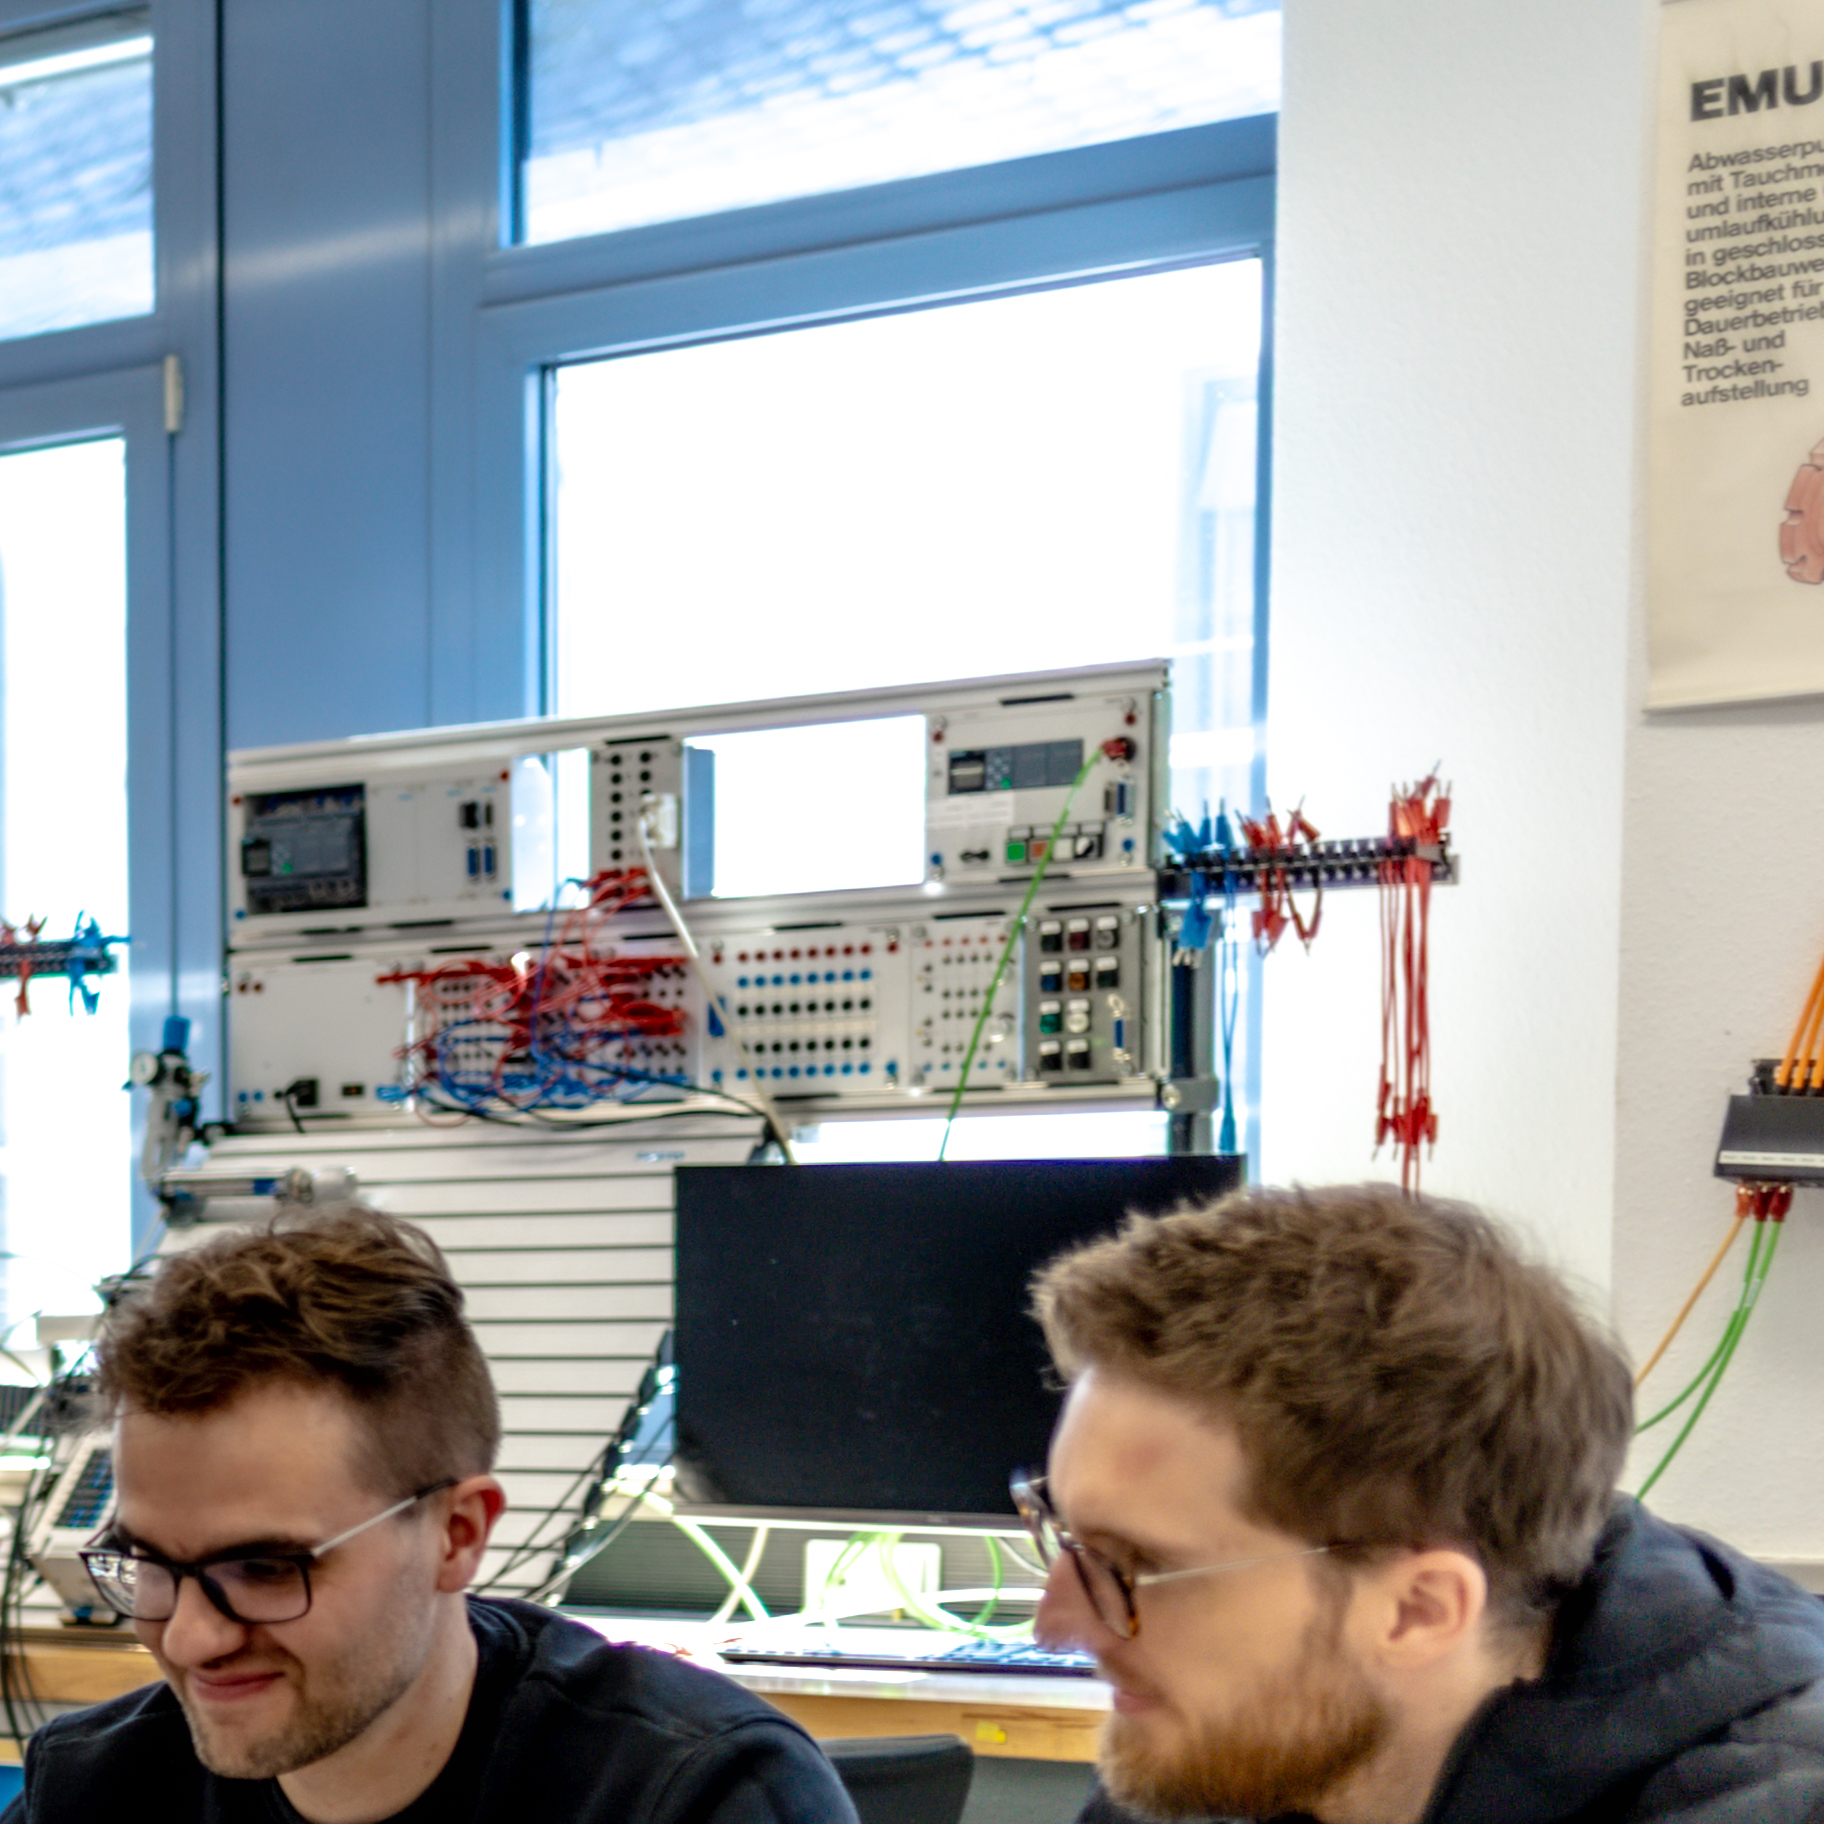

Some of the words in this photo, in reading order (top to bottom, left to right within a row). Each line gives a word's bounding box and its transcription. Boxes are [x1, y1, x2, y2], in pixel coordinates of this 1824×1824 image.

[1691, 60, 1824, 121] EMU
[1687, 174, 1724, 196] mit
[1686, 196, 1729, 219] und
[1736, 187, 1817, 213] interne
[1686, 207, 1824, 243] umlaufkühlu
[1685, 249, 1705, 266] in
[1685, 258, 1824, 290] Blockbauwe
[1684, 283, 1785, 317] geeignet
[1792, 279, 1824, 299] für
[1683, 338, 1737, 360] Naß-
[1742, 330, 1786, 352] und
[1682, 359, 1784, 383] Trocken-
[1681, 378, 1809, 407] aufstellung
